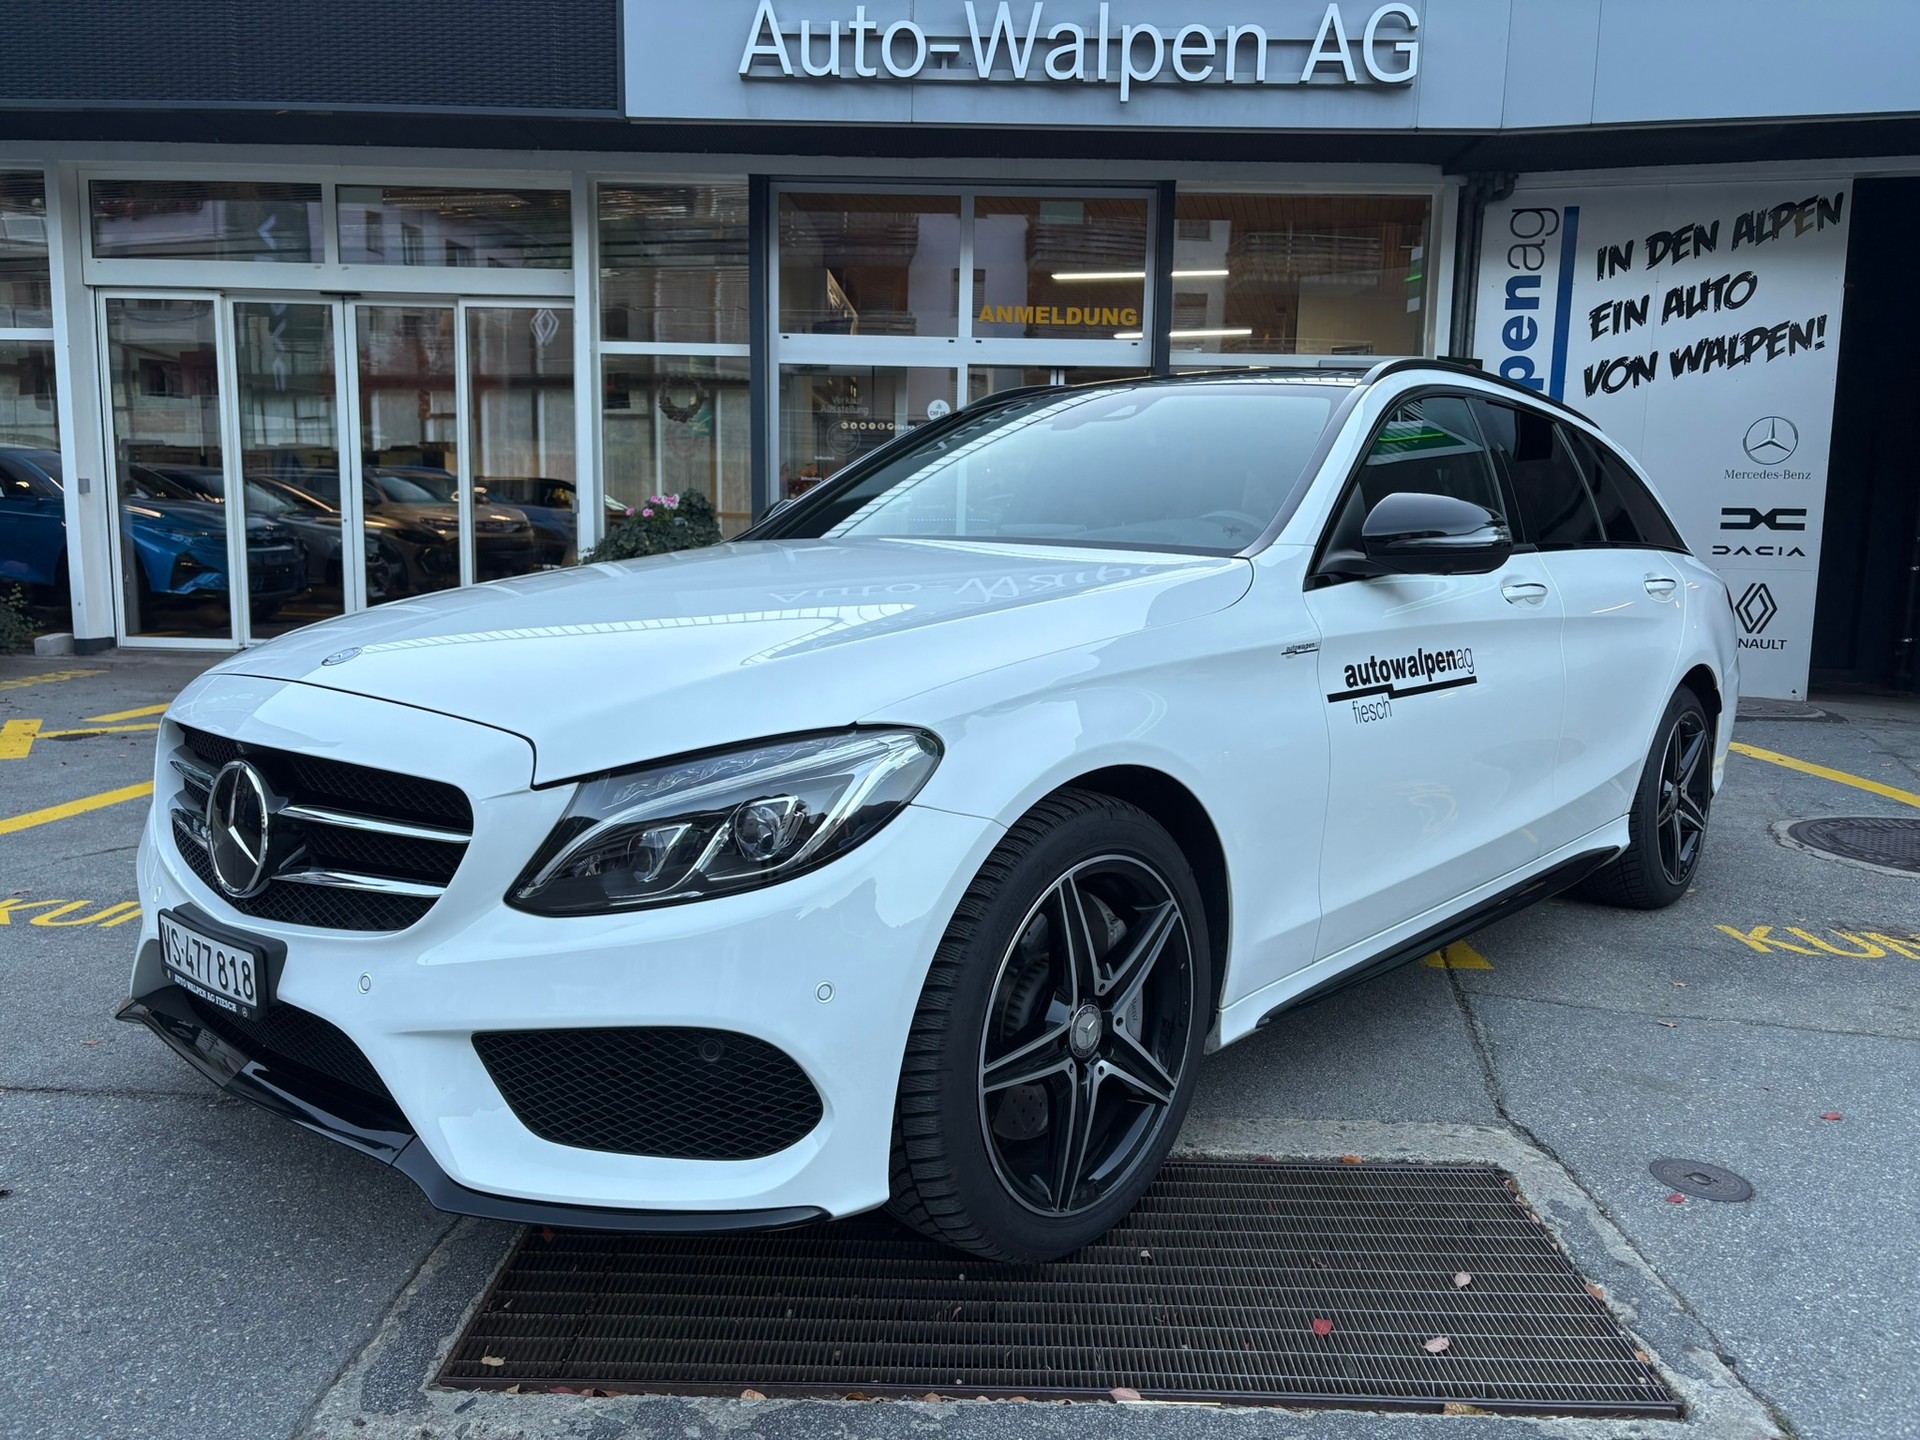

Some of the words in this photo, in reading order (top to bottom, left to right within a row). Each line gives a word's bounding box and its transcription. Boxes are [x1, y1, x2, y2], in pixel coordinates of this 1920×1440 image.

[738, 0, 1268, 102] Auto-Walpen
[1300, 2, 1419, 84] AG
[1596, 239, 1634, 282] IN
[1645, 219, 1720, 271] DEN
[1731, 192, 1844, 251] ALPEN
[978, 304, 1139, 326] ANMELDUNG
[1589, 294, 1650, 342] EIN
[1661, 270, 1758, 325] AUTO
[1583, 350, 1659, 398] VON
[1669, 314, 1828, 379] WALPEN!
[820, 404, 869, 416] Ausstellung
[1723, 469, 1812, 480] Mercedes-Benz
[1711, 545, 1806, 557] DACIA
[1737, 638, 1788, 650] NAULT
[1344, 647, 1475, 688] autowalpenag
[1352, 696, 1393, 724] fiesch
